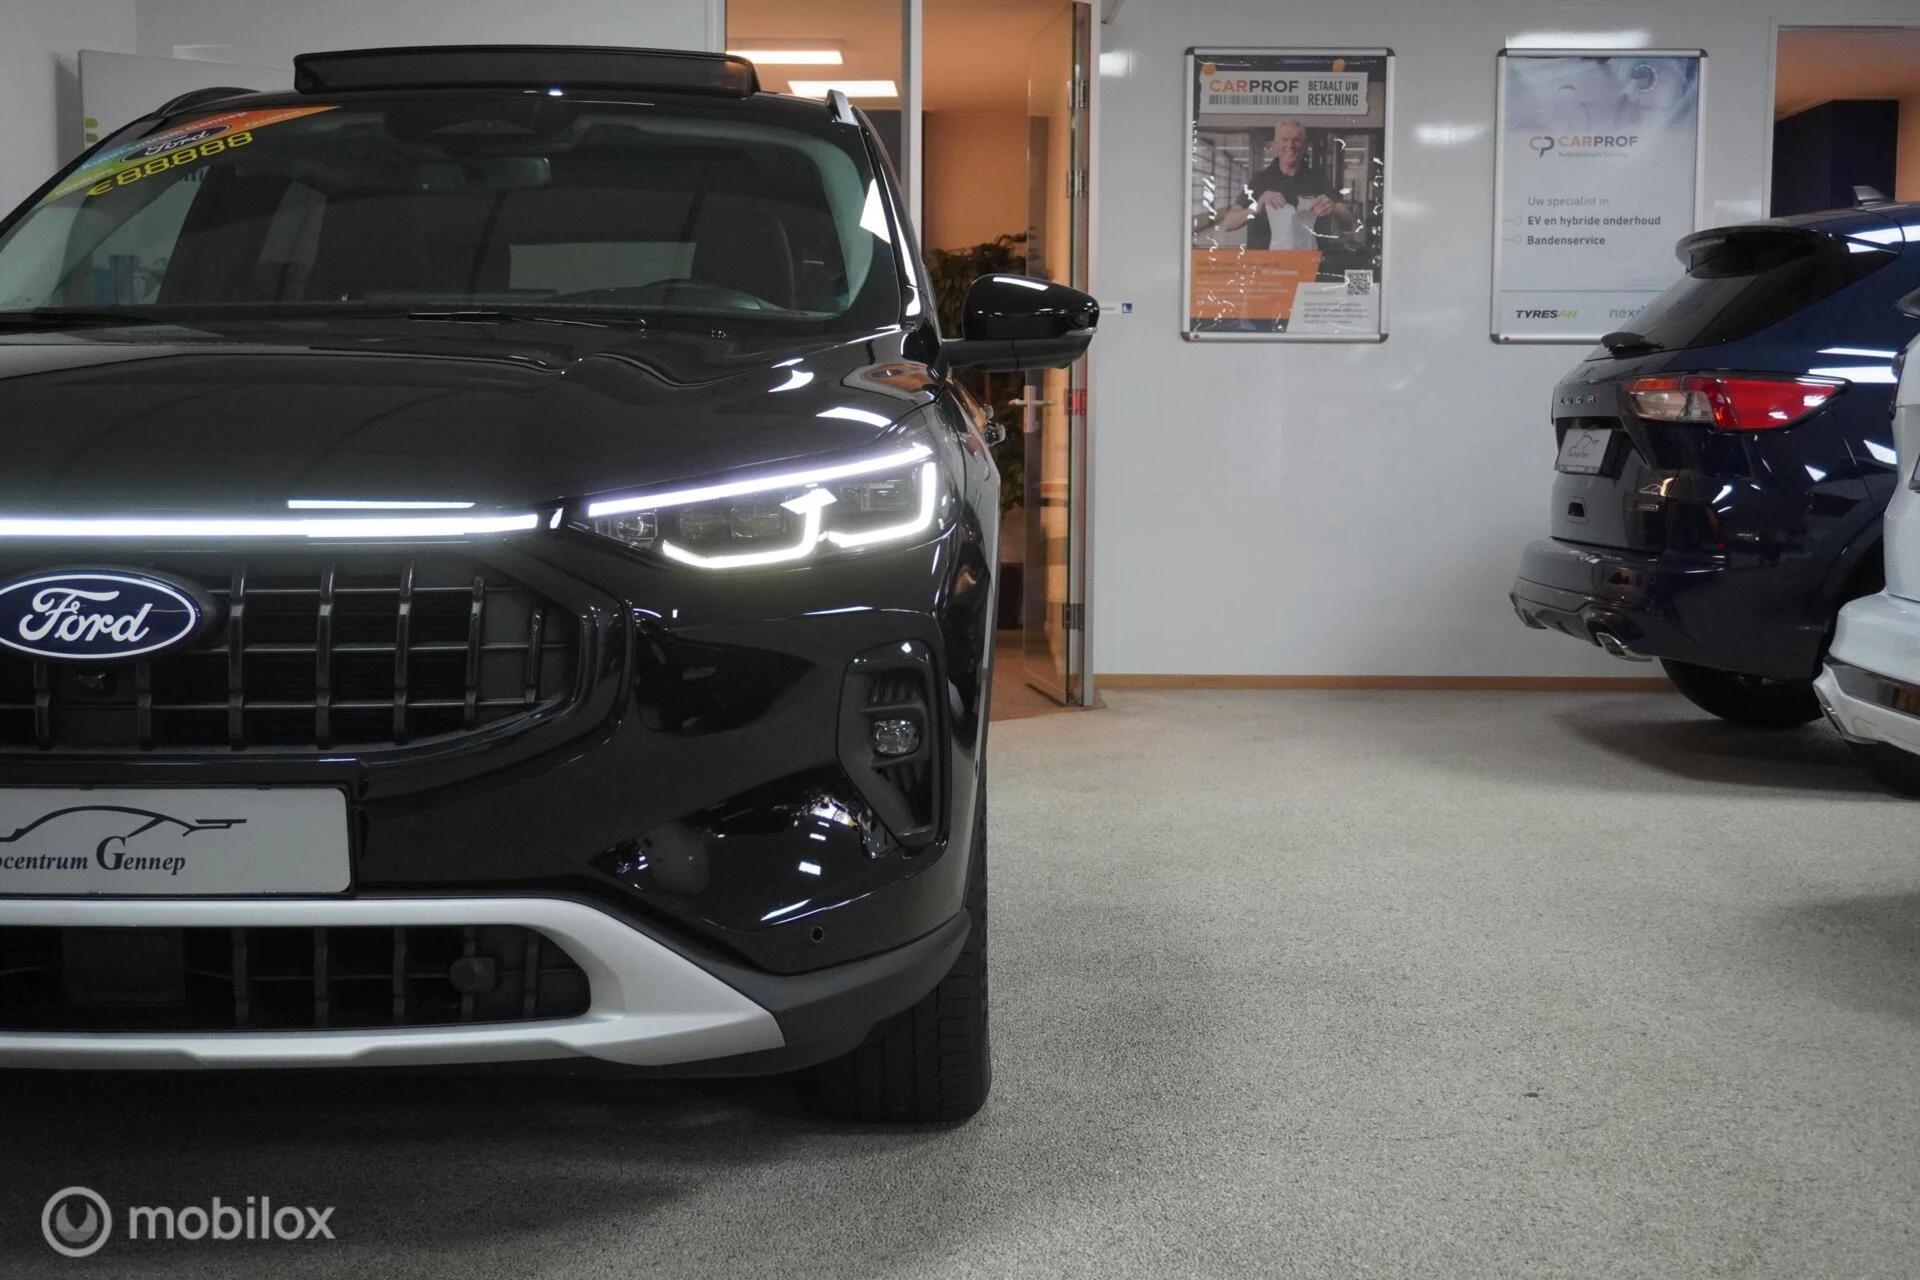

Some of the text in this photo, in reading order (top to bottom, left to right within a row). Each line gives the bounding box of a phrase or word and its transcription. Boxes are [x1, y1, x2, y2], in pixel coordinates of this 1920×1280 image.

[1209, 80, 1299, 93] CARPROF
[1308, 80, 1359, 91] BETAALT UW
[1308, 94, 1359, 106] REKENING
[145, 131, 209, 156] Ford
[1558, 136, 1639, 147] CARPROF
[1528, 196, 1609, 208] Uw specialist in
[1527, 215, 1661, 228] EV en hybride onderhoud
[1527, 235, 1606, 245] Bandenservice
[19, 587, 153, 642] Ford
[0, 836, 187, 876] centrum Gennep
